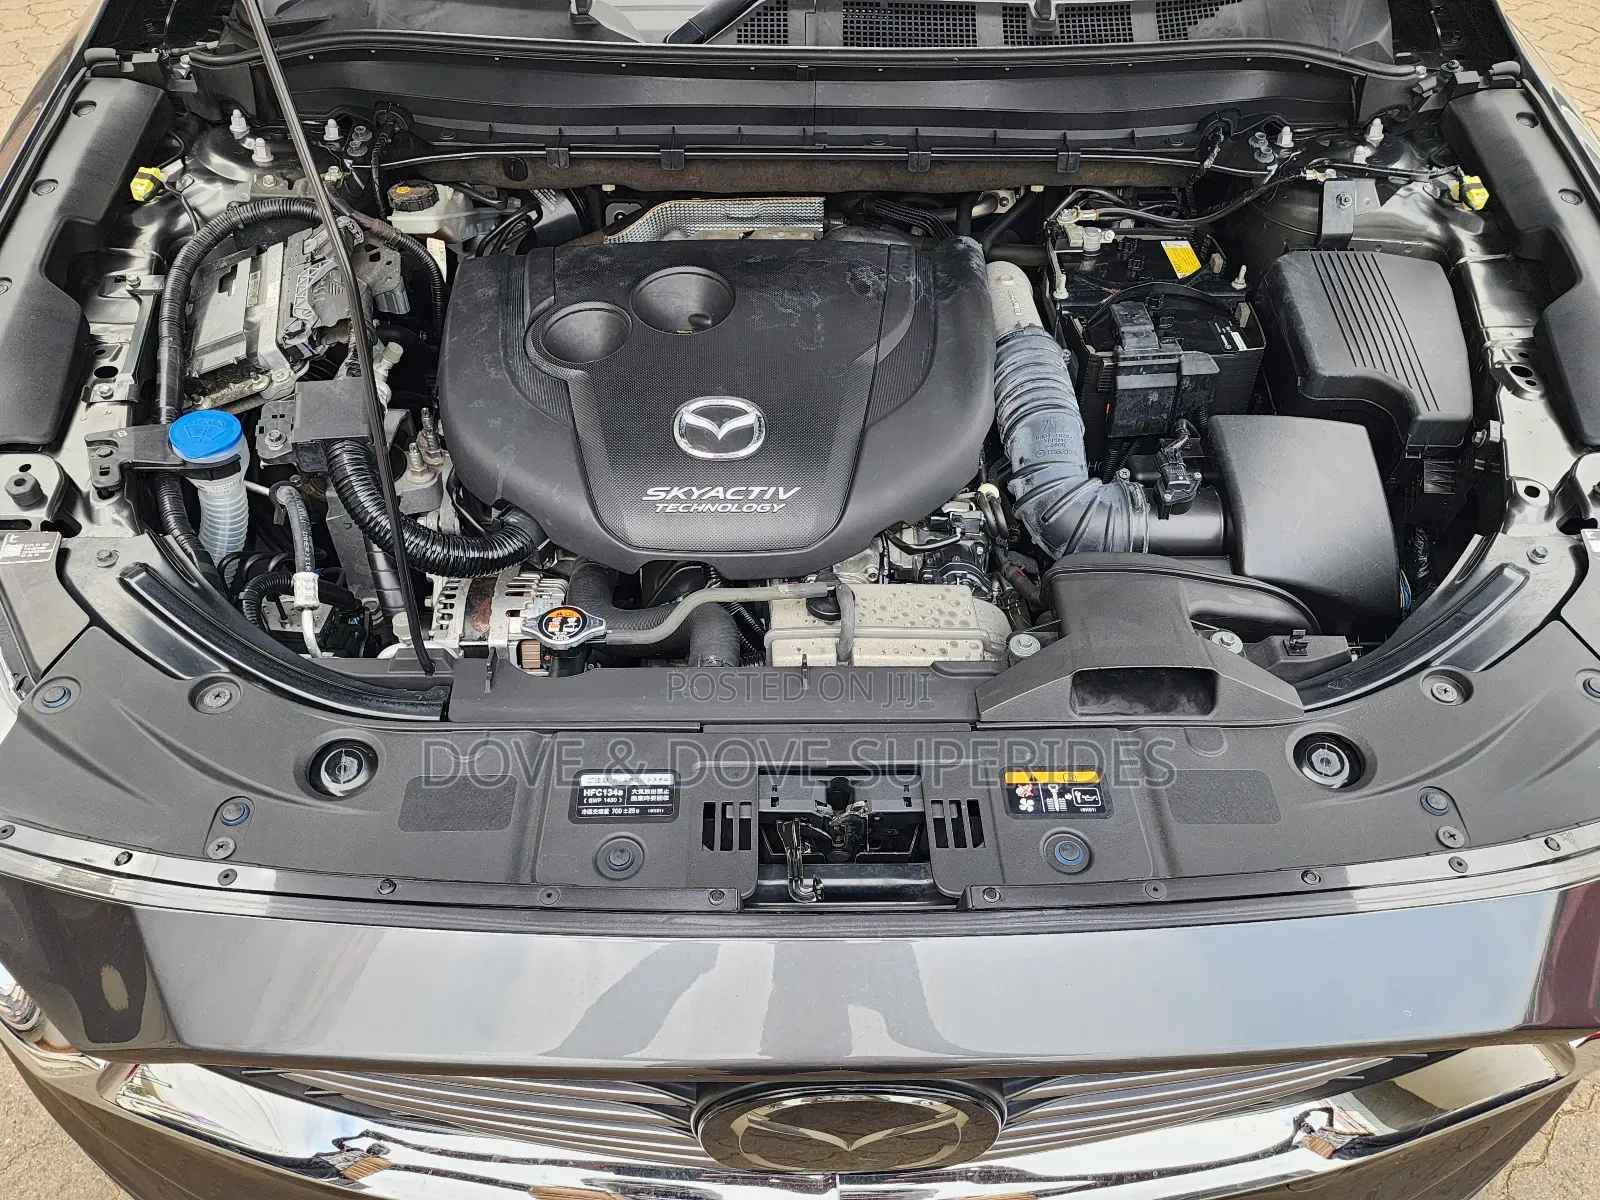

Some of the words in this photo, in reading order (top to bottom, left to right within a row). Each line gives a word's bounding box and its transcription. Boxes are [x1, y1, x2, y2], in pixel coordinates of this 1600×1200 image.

[642, 486, 801, 500] SKYACTIV
[655, 503, 786, 513] TECHNOLOGY
[583, 788, 623, 797] HFC134a
